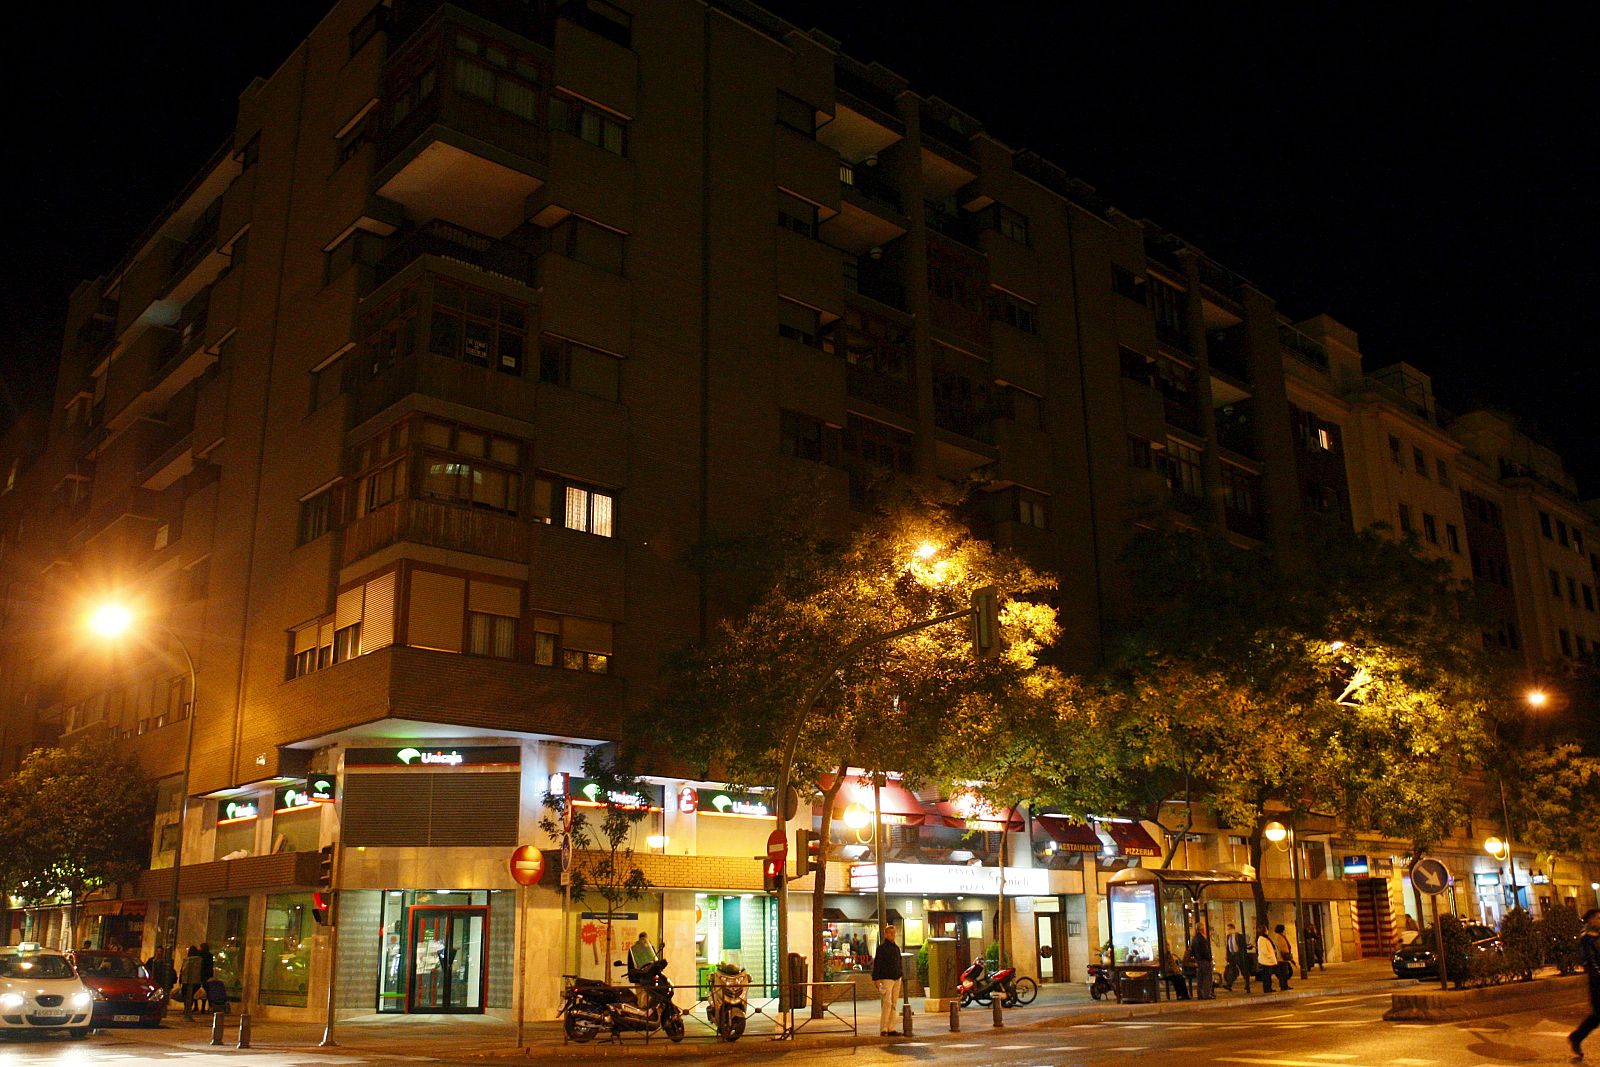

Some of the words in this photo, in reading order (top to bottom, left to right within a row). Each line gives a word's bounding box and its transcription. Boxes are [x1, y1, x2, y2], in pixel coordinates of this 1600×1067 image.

[421, 751, 462, 766] Unicaja
[1125, 847, 1154, 856] PIZZERIA
[1352, 856, 1359, 864] P
[770, 903, 778, 991] www.unicaja.es
